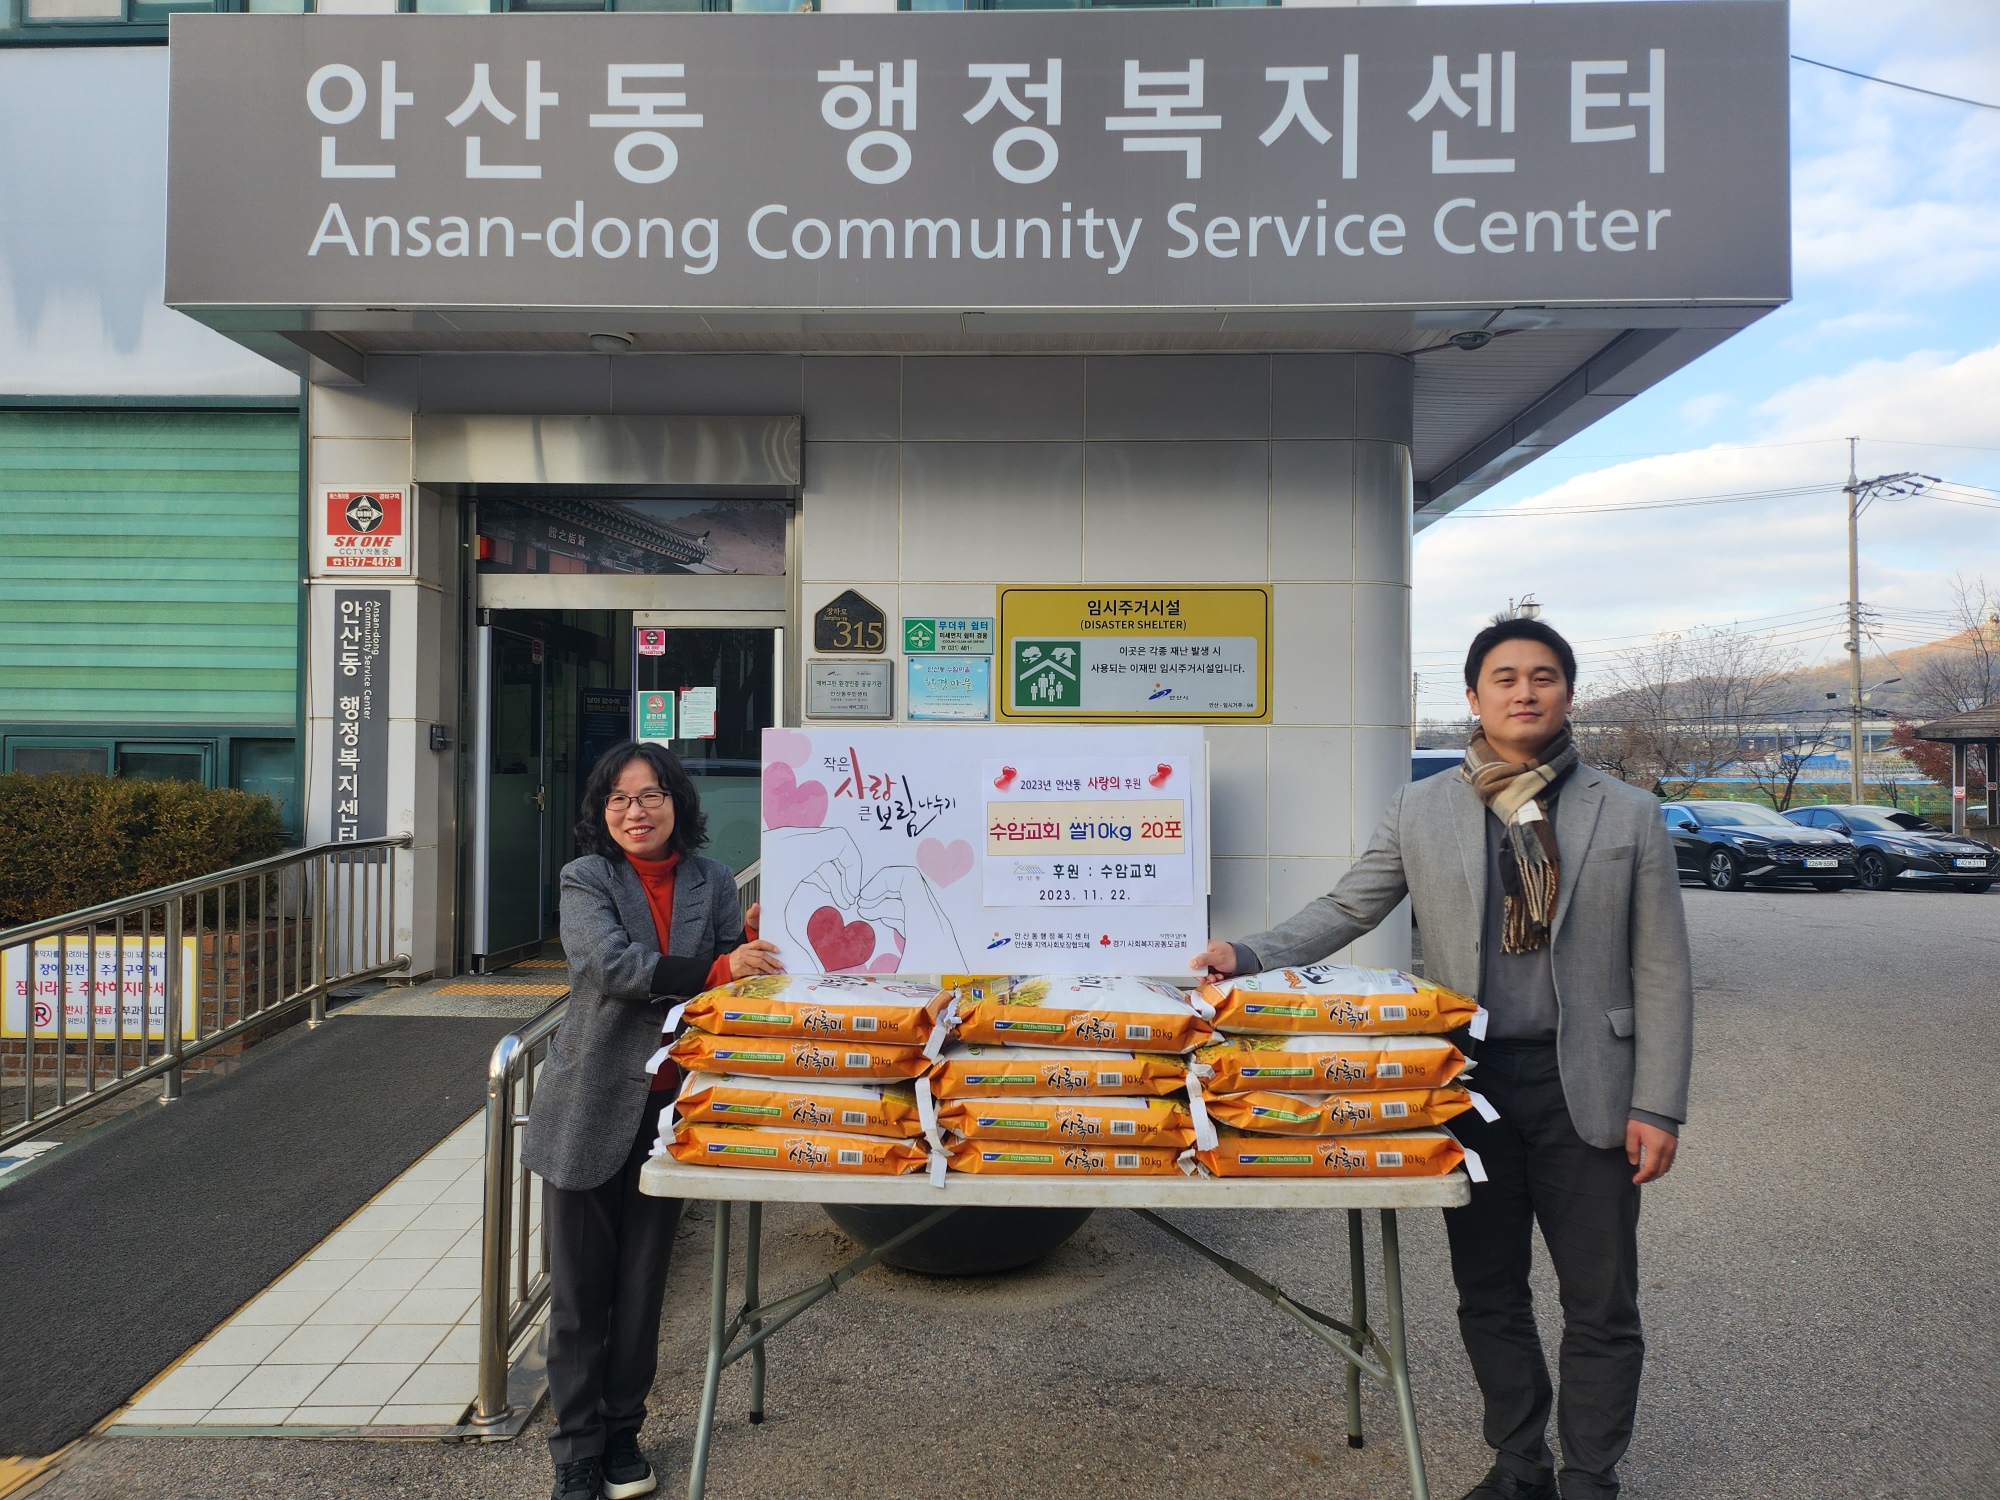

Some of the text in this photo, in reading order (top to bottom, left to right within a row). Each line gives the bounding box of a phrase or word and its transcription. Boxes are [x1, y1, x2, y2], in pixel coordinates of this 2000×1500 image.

[306, 48, 1665, 185] 안산동 행정복지센터
[307, 197, 1671, 275] Ansan-dong Community Service Center
[334, 536, 394, 547] SK ONE
[342, 557, 396, 567] 1577-4473
[1087, 600, 1180, 616] 임시주거시설
[371, 601, 382, 656] Ansan-dong
[938, 621, 988, 631] 무더위 쉼터
[1080, 620, 1187, 631] (DISASTER SHELTER)
[833, 621, 883, 648] 315
[1119, 646, 1221, 656] 이곳은 각종 재난 발생 시
[363, 601, 373, 720] Community Service Center
[1091, 663, 1245, 674] 사용되는 이재민 임시주거시설입니다.
[337, 600, 362, 842] 안산동 행정복지센터
[823, 746, 897, 801] 작은 사랑
[1020, 776, 1141, 791] 2023년 안산동 사랑의 후원
[858, 775, 956, 837] 큰 보람 나누기
[990, 820, 1182, 841] 수암교회 쌀10kg 20포
[1053, 864, 1080, 879] 후원
[1100, 864, 1156, 879] 수암교회
[1039, 889, 1131, 900] 2023. 11. 22.
[1014, 941, 1033, 949] 안산동
[1112, 940, 1187, 948] 경기 사회복지공동모금회
[1329, 1001, 1369, 1030] 상록미
[1407, 1007, 1429, 1018] 10 kg
[803, 1010, 842, 1036] 상록미
[878, 1020, 899, 1031] 10 kg
[1076, 1017, 1115, 1045] 상록미
[1152, 1029, 1172, 1040] 10 kg
[796, 1047, 834, 1075] 상록미
[871, 1056, 892, 1067] 10 kg
[1325, 1058, 1366, 1087] 상록미
[1404, 1065, 1425, 1076] 10 kg
[1047, 1067, 1087, 1093] 상록미
[1123, 1075, 1144, 1086] 10 kg
[793, 1102, 832, 1128] 상록미
[1331, 1101, 1370, 1128] 상록미
[1408, 1104, 1418, 1112] 10
[867, 1115, 888, 1126] 10 kg
[1060, 1113, 1100, 1139] 상록미
[1137, 1124, 1158, 1135] 10 kg
[789, 1142, 828, 1169] 상록미
[863, 1154, 884, 1165] 10 kg
[1065, 1148, 1104, 1174] 상록미
[1140, 1157, 1162, 1168] 10 kg
[1324, 1147, 1365, 1174] 상록미
[1404, 1155, 1425, 1165] 10 kg
